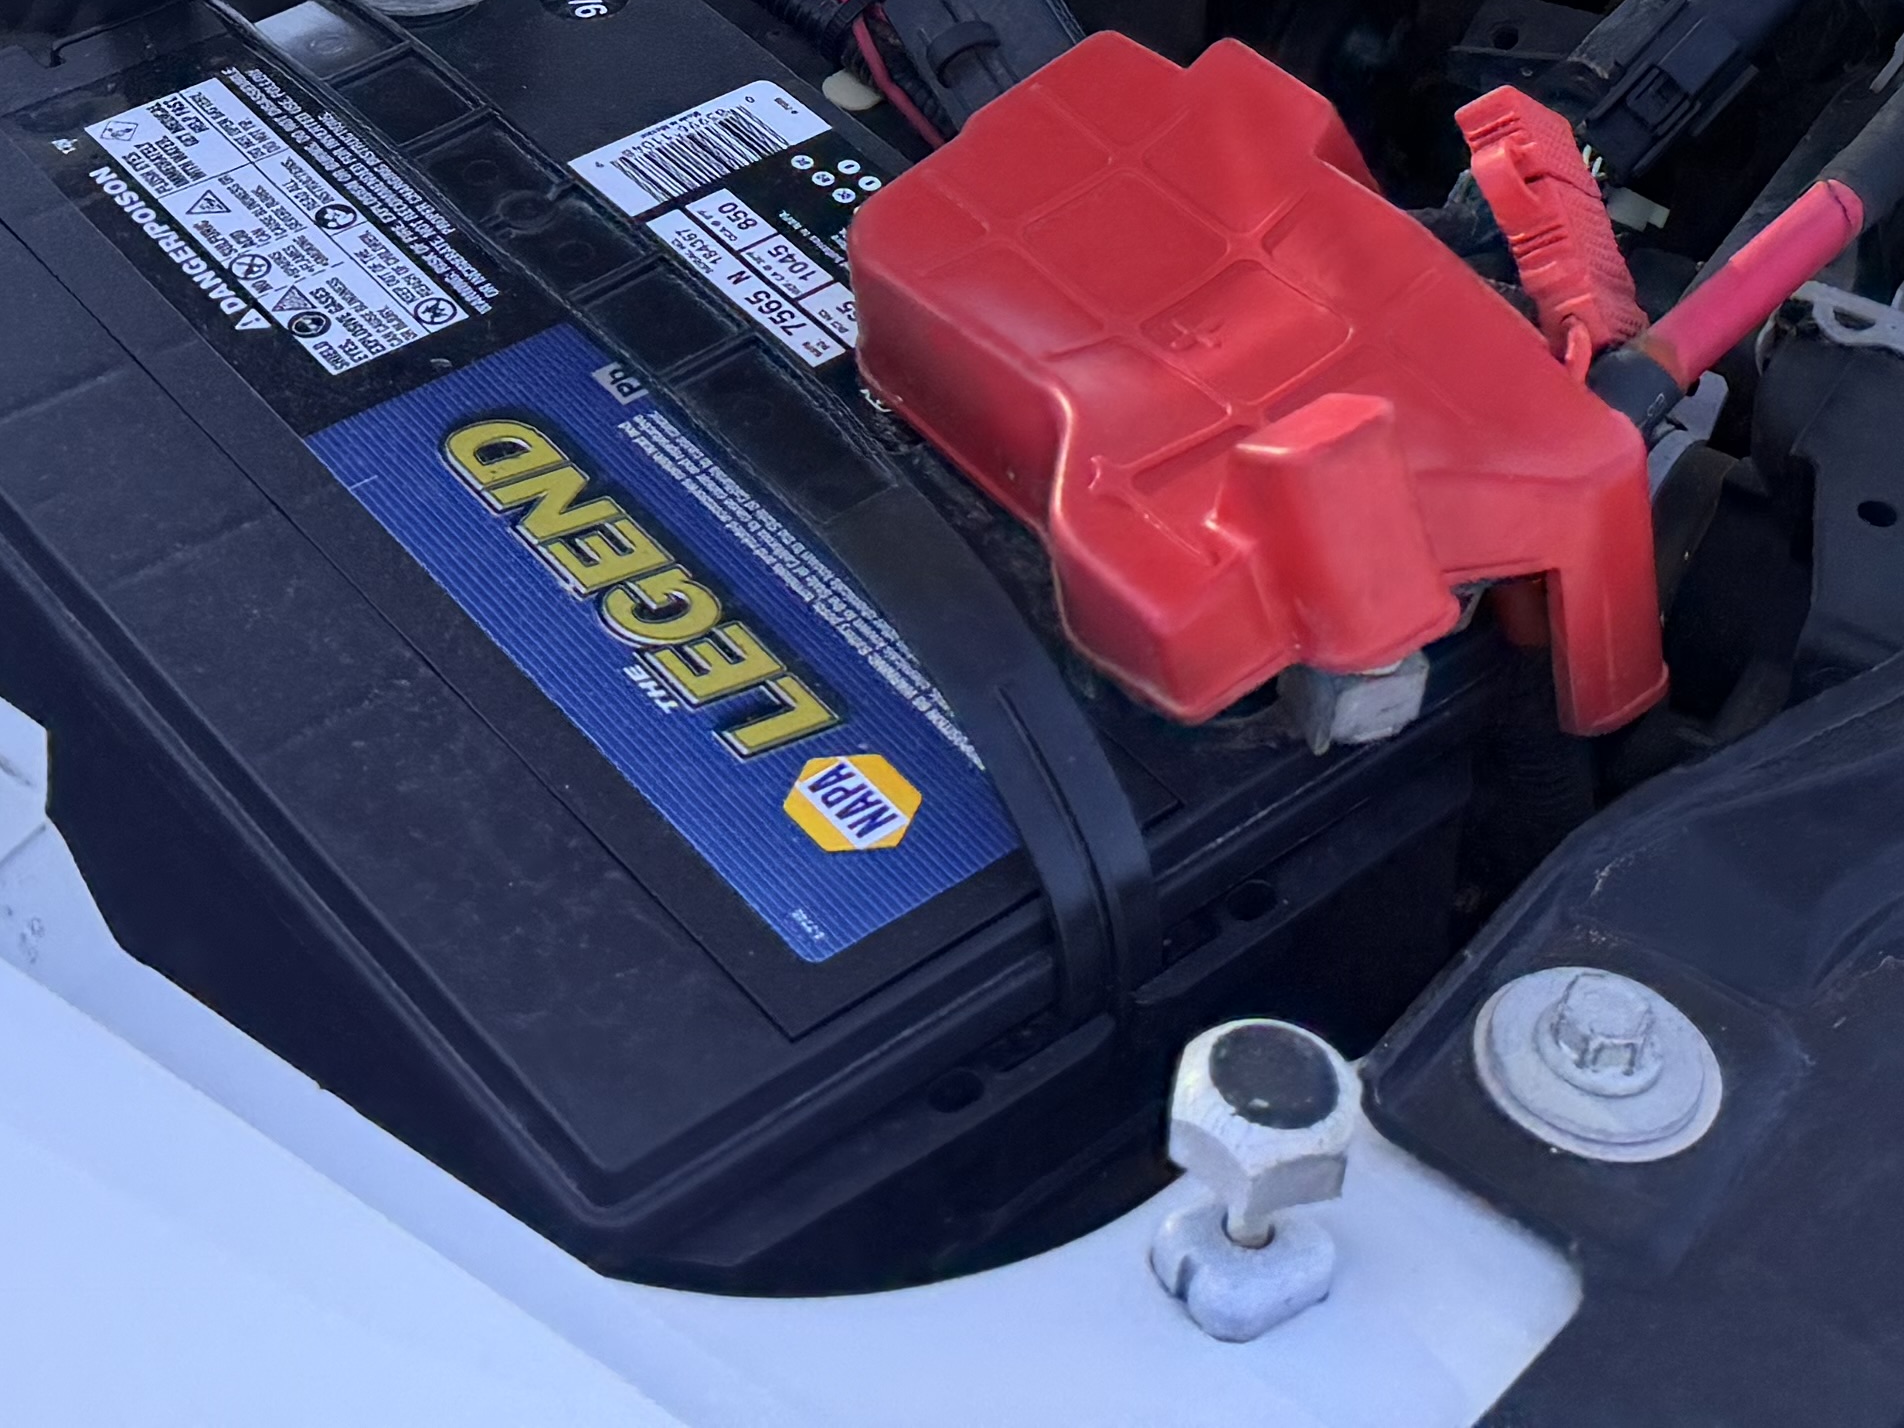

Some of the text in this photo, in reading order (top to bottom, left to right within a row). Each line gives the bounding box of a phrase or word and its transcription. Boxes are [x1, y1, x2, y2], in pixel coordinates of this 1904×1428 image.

[713, 200, 760, 231] 850
[87, 165, 248, 314] DANGER/POISON
[717, 226, 739, 242] CCA
[725, 269, 752, 285] N
[765, 242, 819, 282] 1045
[769, 270, 785, 282] CA
[249, 278, 273, 294] NO
[742, 287, 810, 336] 7565
[604, 368, 643, 396] Pb
[437, 417, 843, 764] LEGEND
[622, 663, 680, 715] THE
[803, 762, 901, 840] NAPA
